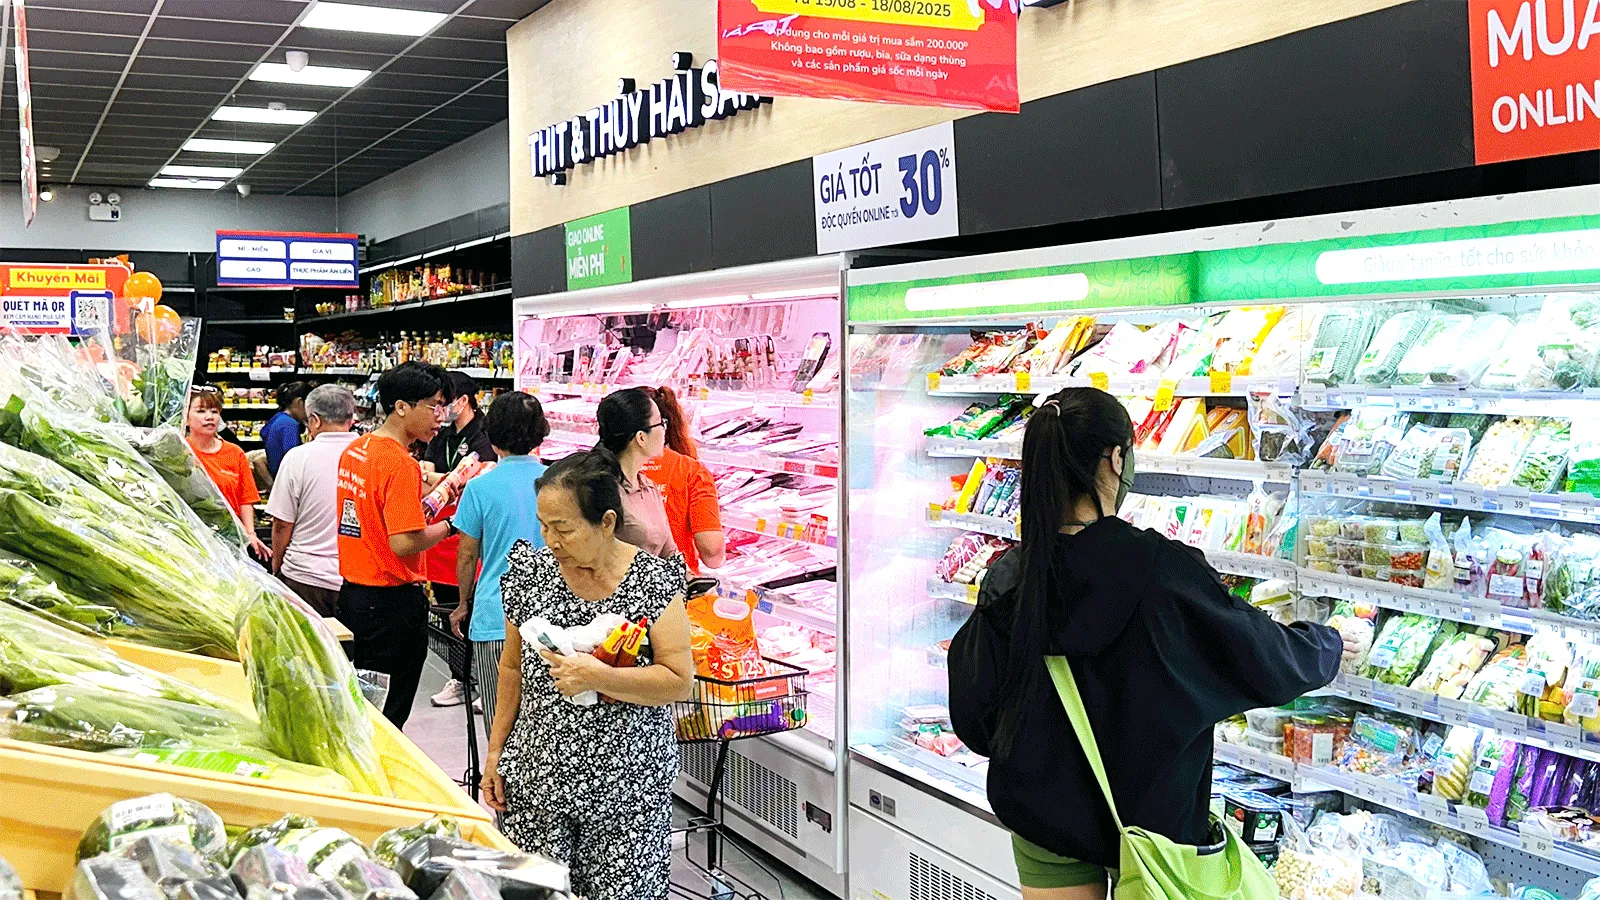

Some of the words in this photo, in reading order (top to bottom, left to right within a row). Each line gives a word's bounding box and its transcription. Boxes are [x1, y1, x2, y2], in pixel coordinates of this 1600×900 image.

[872, 0, 951, 17] 18/08/2025
[785, 27, 810, 40] dụng
[812, 30, 831, 39] cho
[832, 30, 851, 41] mỗi
[852, 32, 867, 45] giá
[868, 34, 881, 46] trị
[882, 37, 903, 46] mua
[905, 35, 924, 47] sắm
[771, 41, 803, 54] Không
[805, 44, 824, 55] bao
[825, 45, 847, 58] gồm
[849, 48, 875, 60] rượu,
[876, 49, 893, 61] bia,
[895, 50, 912, 62] sữa
[913, 52, 937, 65] dạng
[939, 54, 967, 67] thùng
[791, 58, 803, 68] và
[805, 60, 821, 70] các
[823, 61, 841, 71] sản
[842, 61, 870, 74] phẩm
[871, 63, 887, 76] giá
[888, 64, 905, 76] sốc
[906, 66, 924, 78] mỗi
[926, 68, 948, 80] ngày
[528, 121, 569, 185] THỊT
[570, 116, 585, 163] &
[586, 78, 643, 156] THỦY
[649, 52, 693, 138] HẢI
[820, 161, 847, 204] GIÁ
[849, 151, 882, 199] TỐT
[821, 211, 836, 232] ĐỘC
[863, 205, 890, 223] ONLINE
[568, 229, 582, 248] GIAO
[583, 223, 604, 244] ONLINE
[590, 244, 605, 277] PHÍ
[1363, 253, 1394, 273] Giàu
[1460, 246, 1482, 267] tốt
[1486, 247, 1514, 265] cho
[1520, 242, 1546, 263] sức
[16, 271, 70, 286] Khuyến
[3, 298, 30, 312] QUÉT
[33, 298, 48, 312] MÃ
[51, 300, 65, 313] QR
[1425, 492, 1433, 500] 57
[1470, 495, 1477, 504] 15
[1514, 500, 1523, 509] 39
[1449, 606, 1457, 614] 14
[1550, 624, 1559, 633] 10
[1580, 629, 1588, 638] 12
[1360, 689, 1367, 698] 22
[1411, 701, 1418, 710] 21
[1455, 713, 1462, 721] 21
[1513, 727, 1520, 736] 21
[1564, 739, 1574, 749] 23
[1474, 821, 1482, 830] 27
